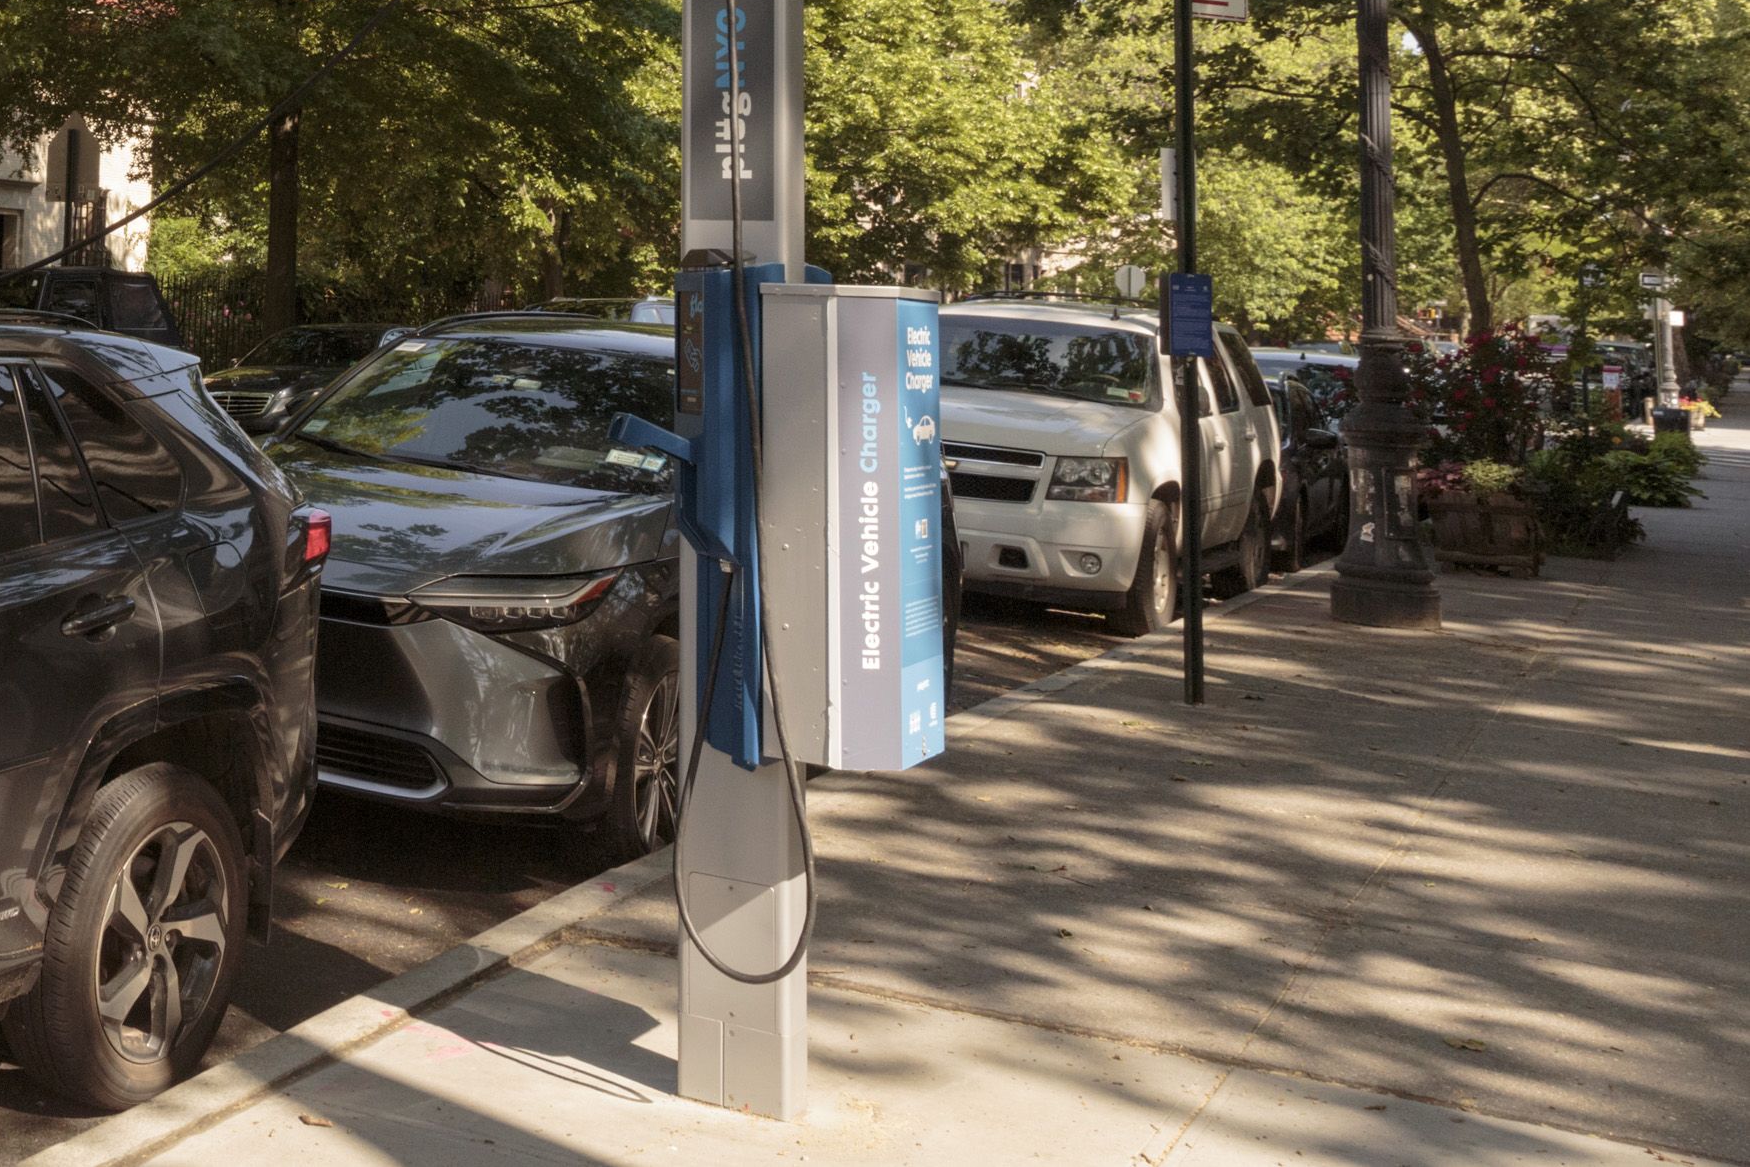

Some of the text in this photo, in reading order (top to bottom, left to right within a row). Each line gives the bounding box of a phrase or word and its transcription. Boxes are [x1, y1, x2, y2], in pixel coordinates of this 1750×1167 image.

[907, 325, 931, 345] Electric
[906, 347, 932, 367] Vehicle
[906, 372, 933, 394] Charger
[860, 372, 881, 670] Electric Vehicle Charger
